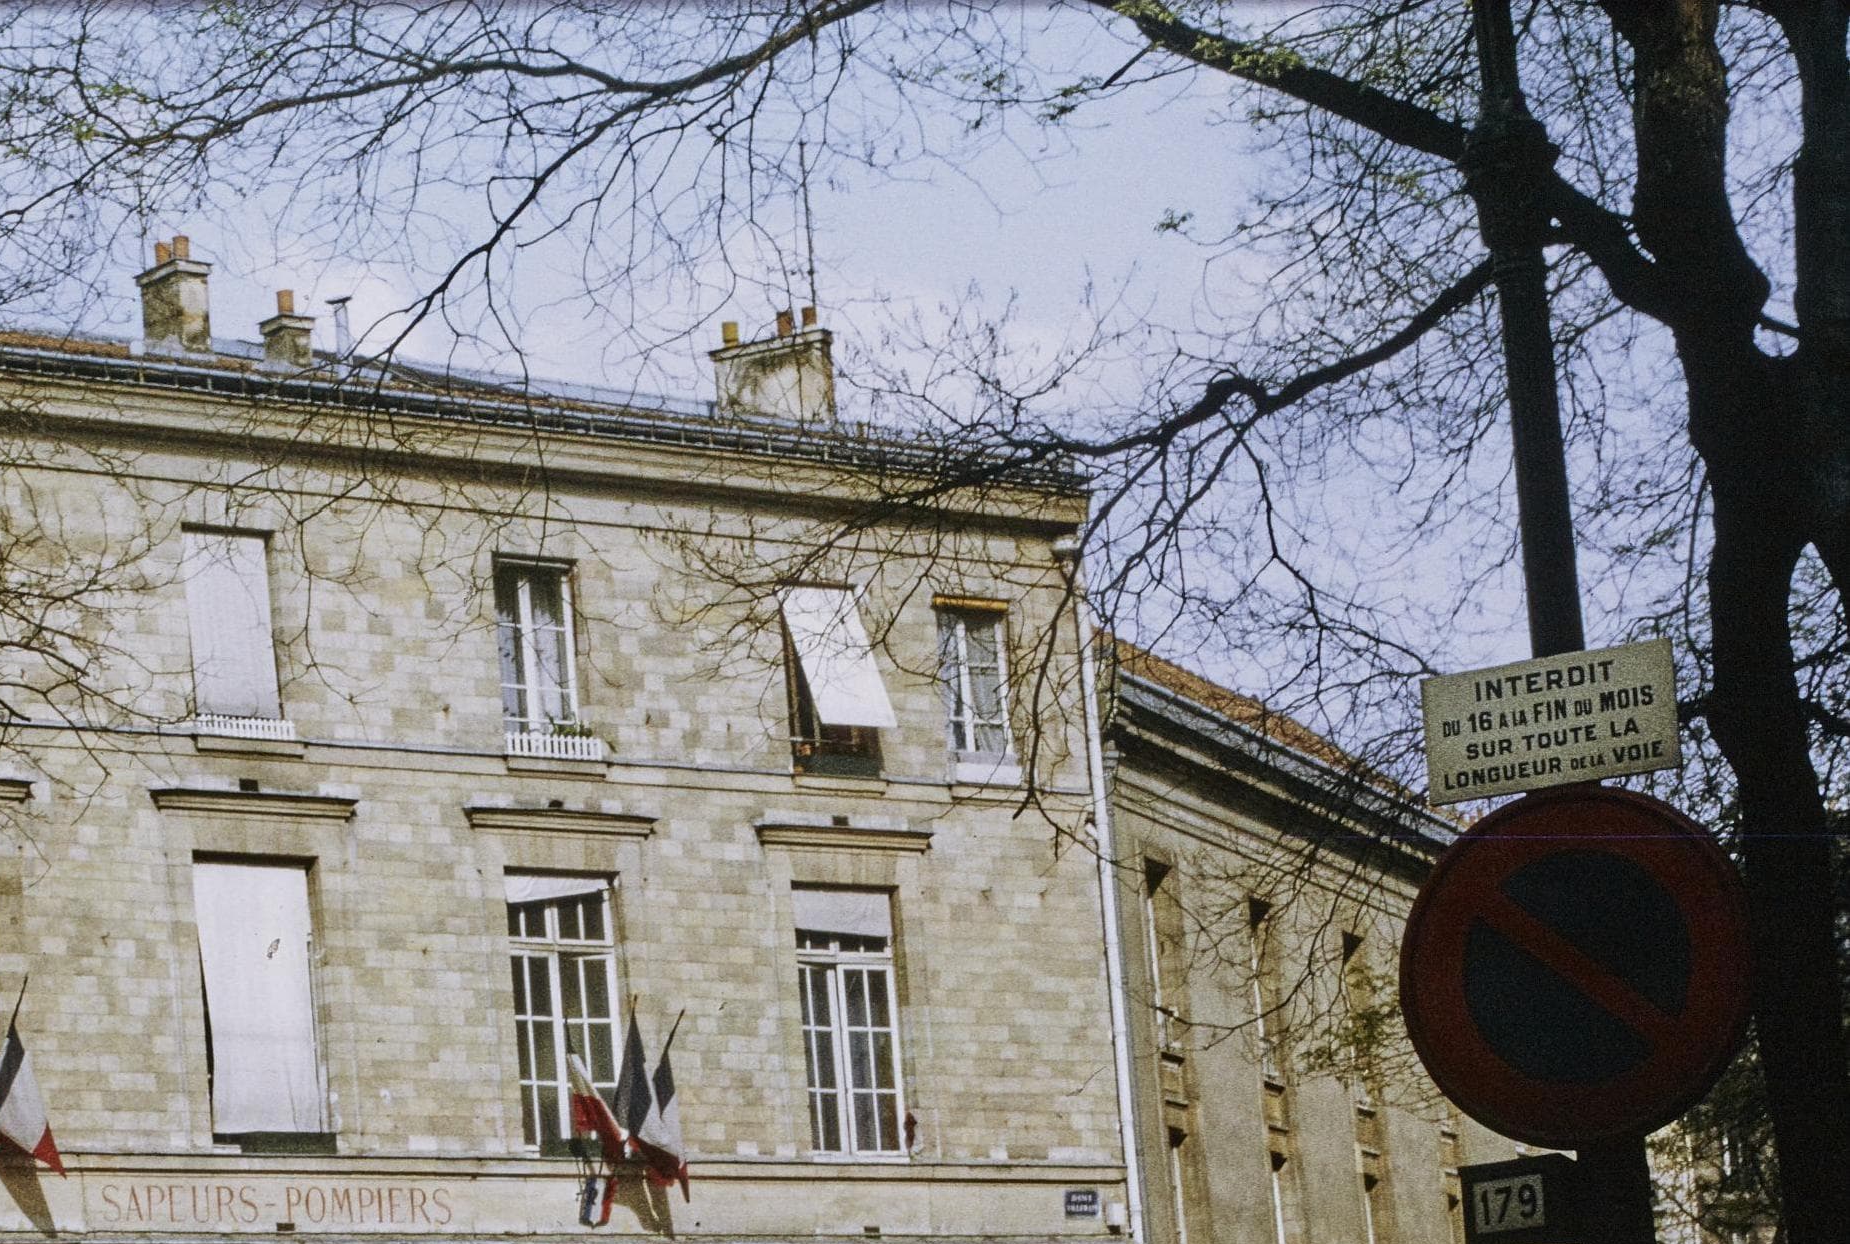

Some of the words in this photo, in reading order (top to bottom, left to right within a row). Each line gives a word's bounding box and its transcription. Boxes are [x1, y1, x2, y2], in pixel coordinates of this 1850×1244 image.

[1475, 660, 1613, 702] INTERDIT
[1442, 720, 1461, 738] DU
[1467, 711, 1492, 733] 16
[1512, 709, 1528, 727] LA
[1533, 698, 1568, 723] FIN
[1574, 698, 1593, 717] DU
[1599, 685, 1654, 712] MOIS
[1466, 738, 1513, 760] SUR
[1522, 724, 1597, 751] TOUTE
[1610, 718, 1640, 738] LA
[1444, 756, 1562, 790] LONGUEUR
[1571, 756, 1587, 771] DE
[1591, 753, 1607, 767] LA
[1612, 740, 1664, 764] VOIE
[1481, 1183, 1537, 1226] 179
